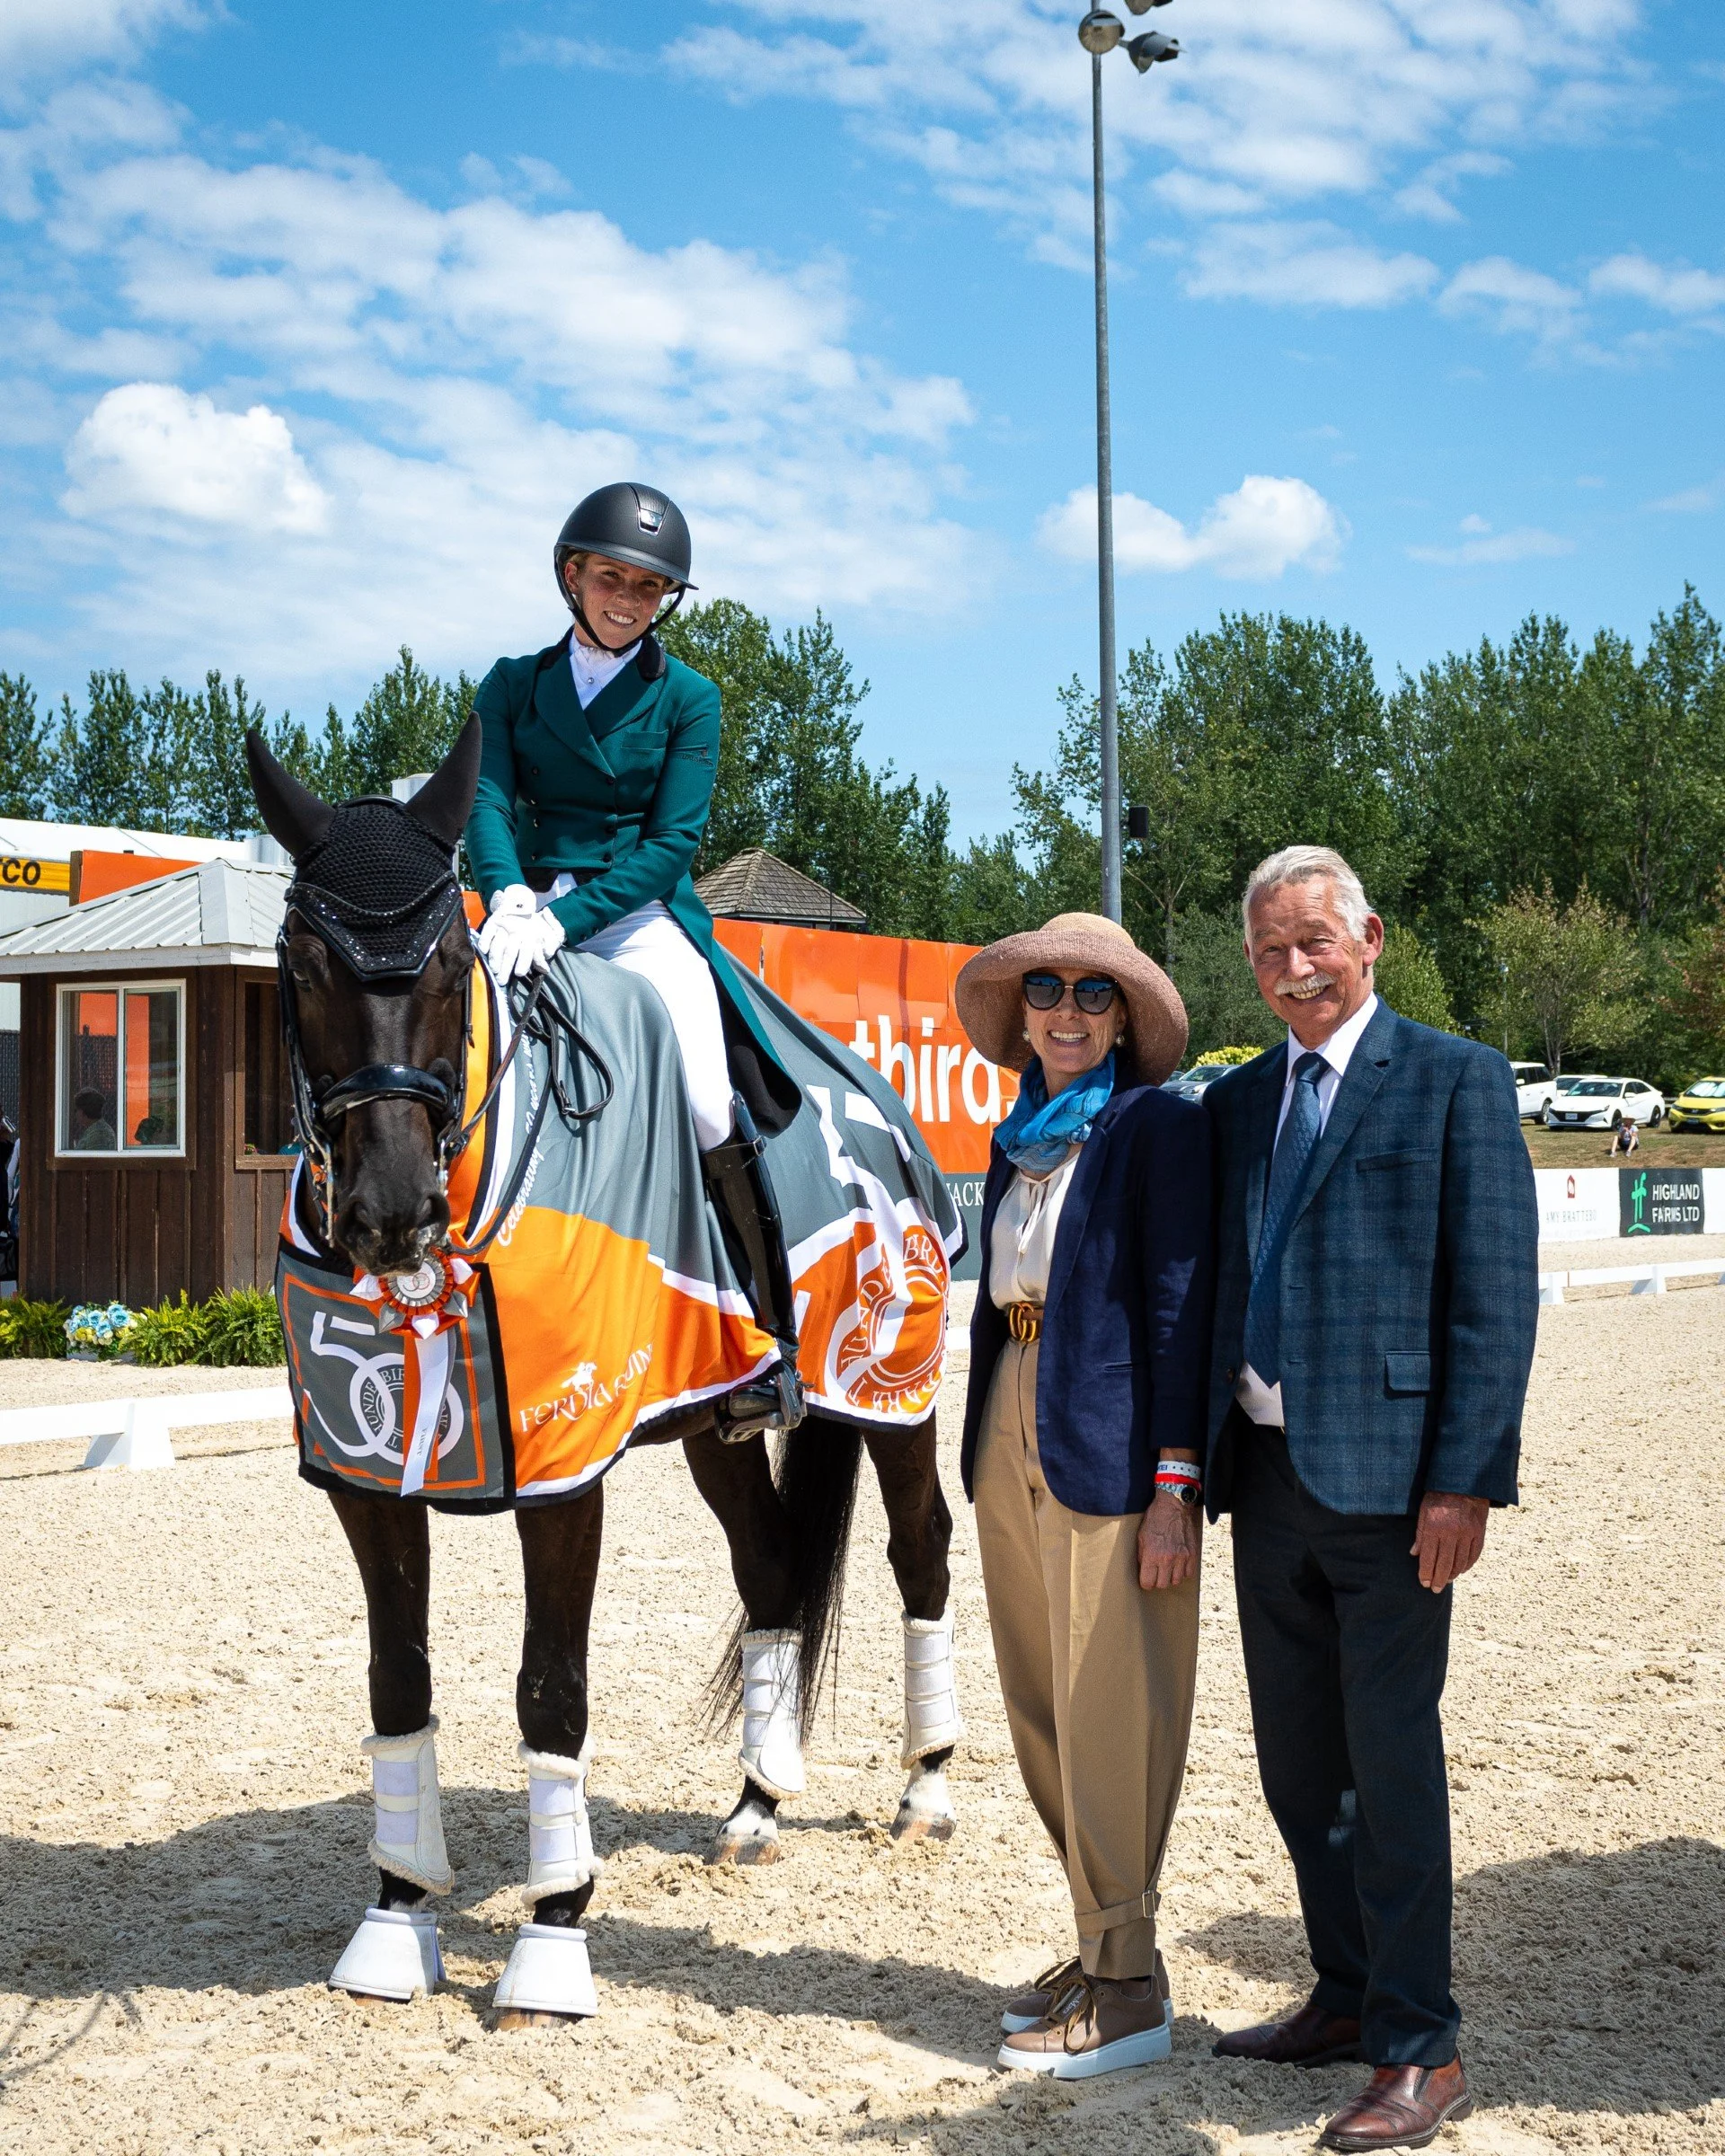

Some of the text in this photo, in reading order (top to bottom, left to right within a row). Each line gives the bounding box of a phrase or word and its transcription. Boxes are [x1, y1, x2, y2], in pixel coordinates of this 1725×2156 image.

[0, 858, 41, 885] CO
[946, 1181, 986, 1207] ACK
[1652, 1184, 1700, 1201] HIGHLAND
[1651, 1206, 1700, 1223] FARMS LTD
[519, 1379, 613, 1432] FERDIA
